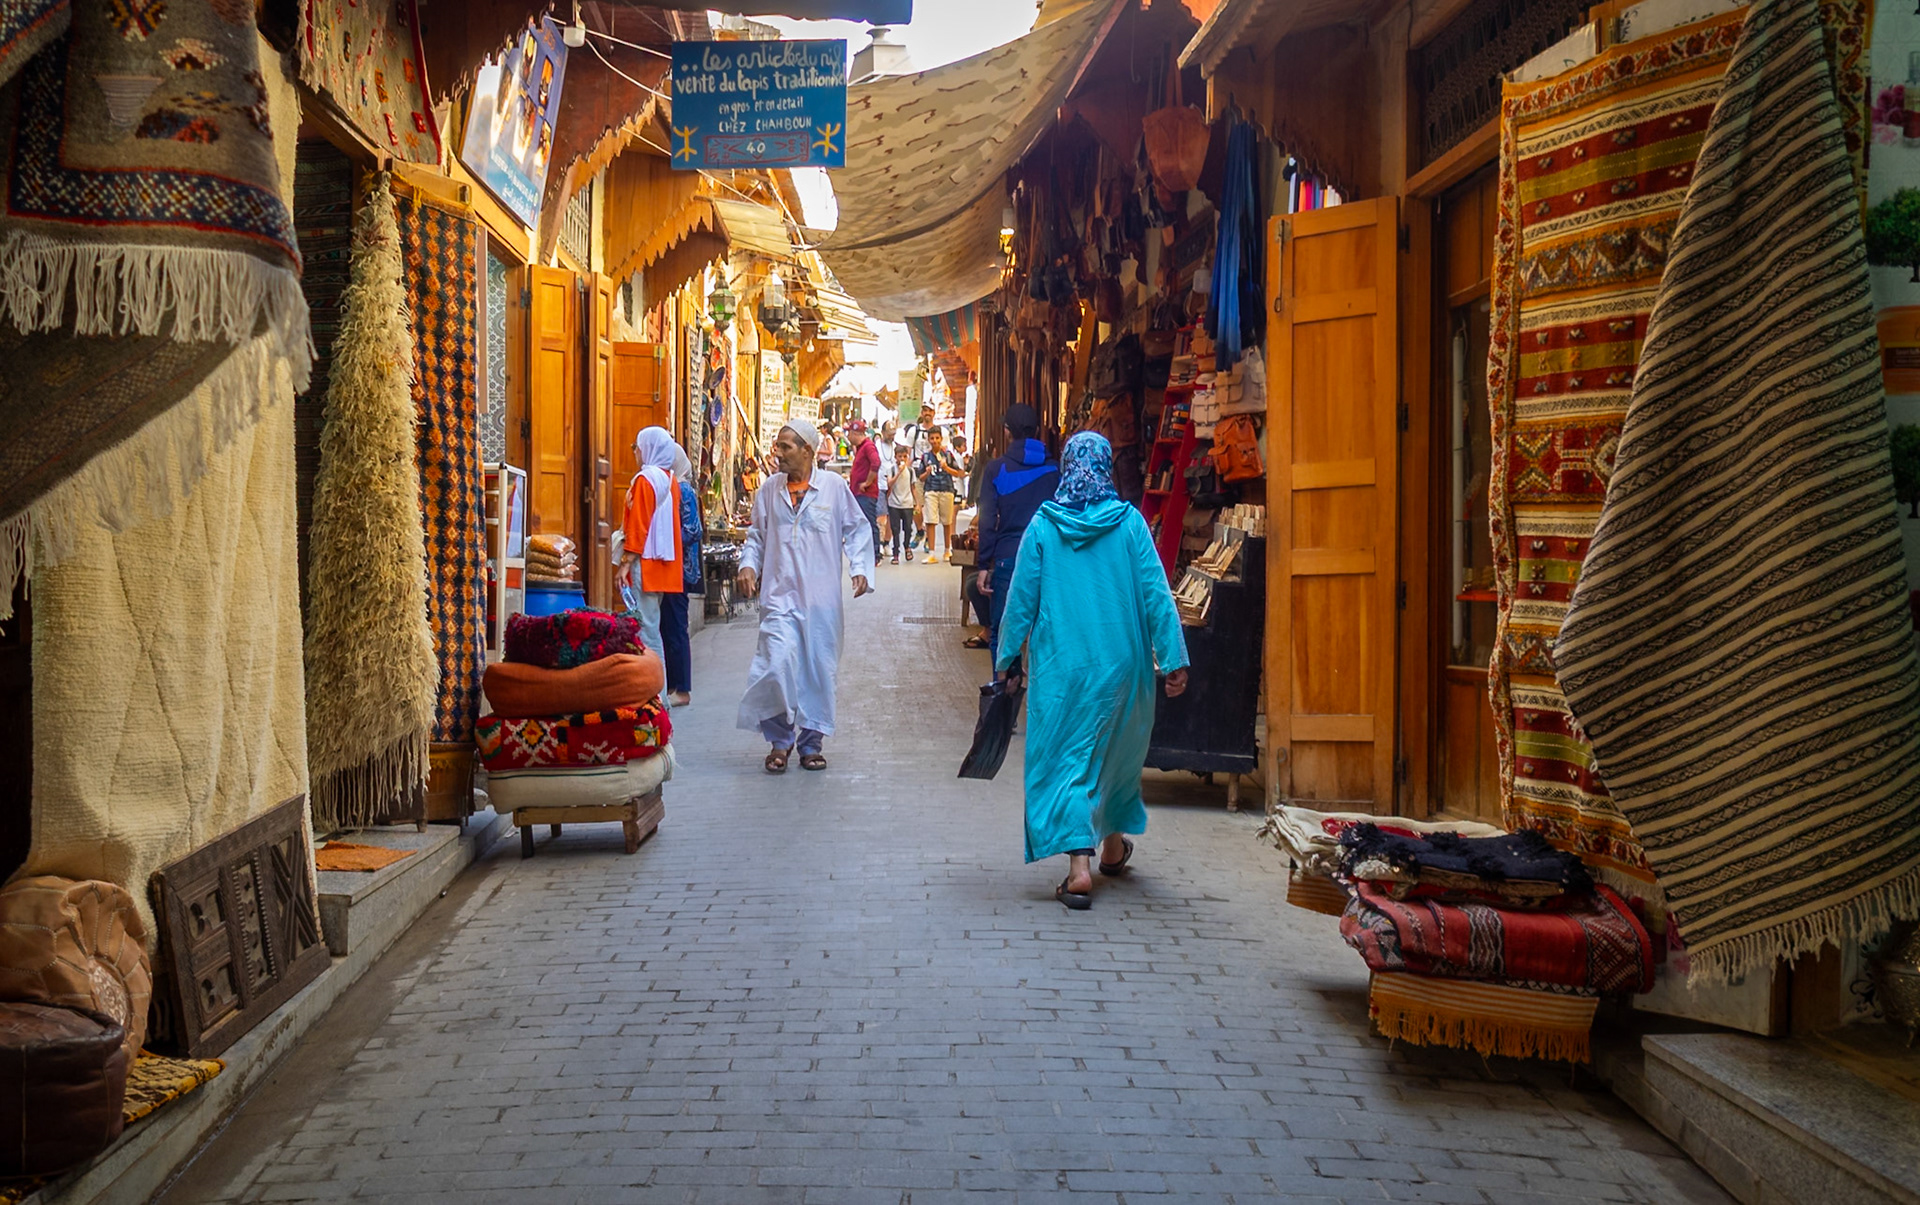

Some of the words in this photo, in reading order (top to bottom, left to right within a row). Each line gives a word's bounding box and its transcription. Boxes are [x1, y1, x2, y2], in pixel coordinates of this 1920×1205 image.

[675, 74, 716, 95] vente
[719, 72, 736, 92] du
[737, 69, 769, 100] tapis
[730, 102, 750, 122] gros
[718, 121, 746, 133] CHEZ
[755, 117, 812, 132] CHAHBOUN
[746, 141, 766, 154] 40
[793, 396, 818, 406] ARGAN
